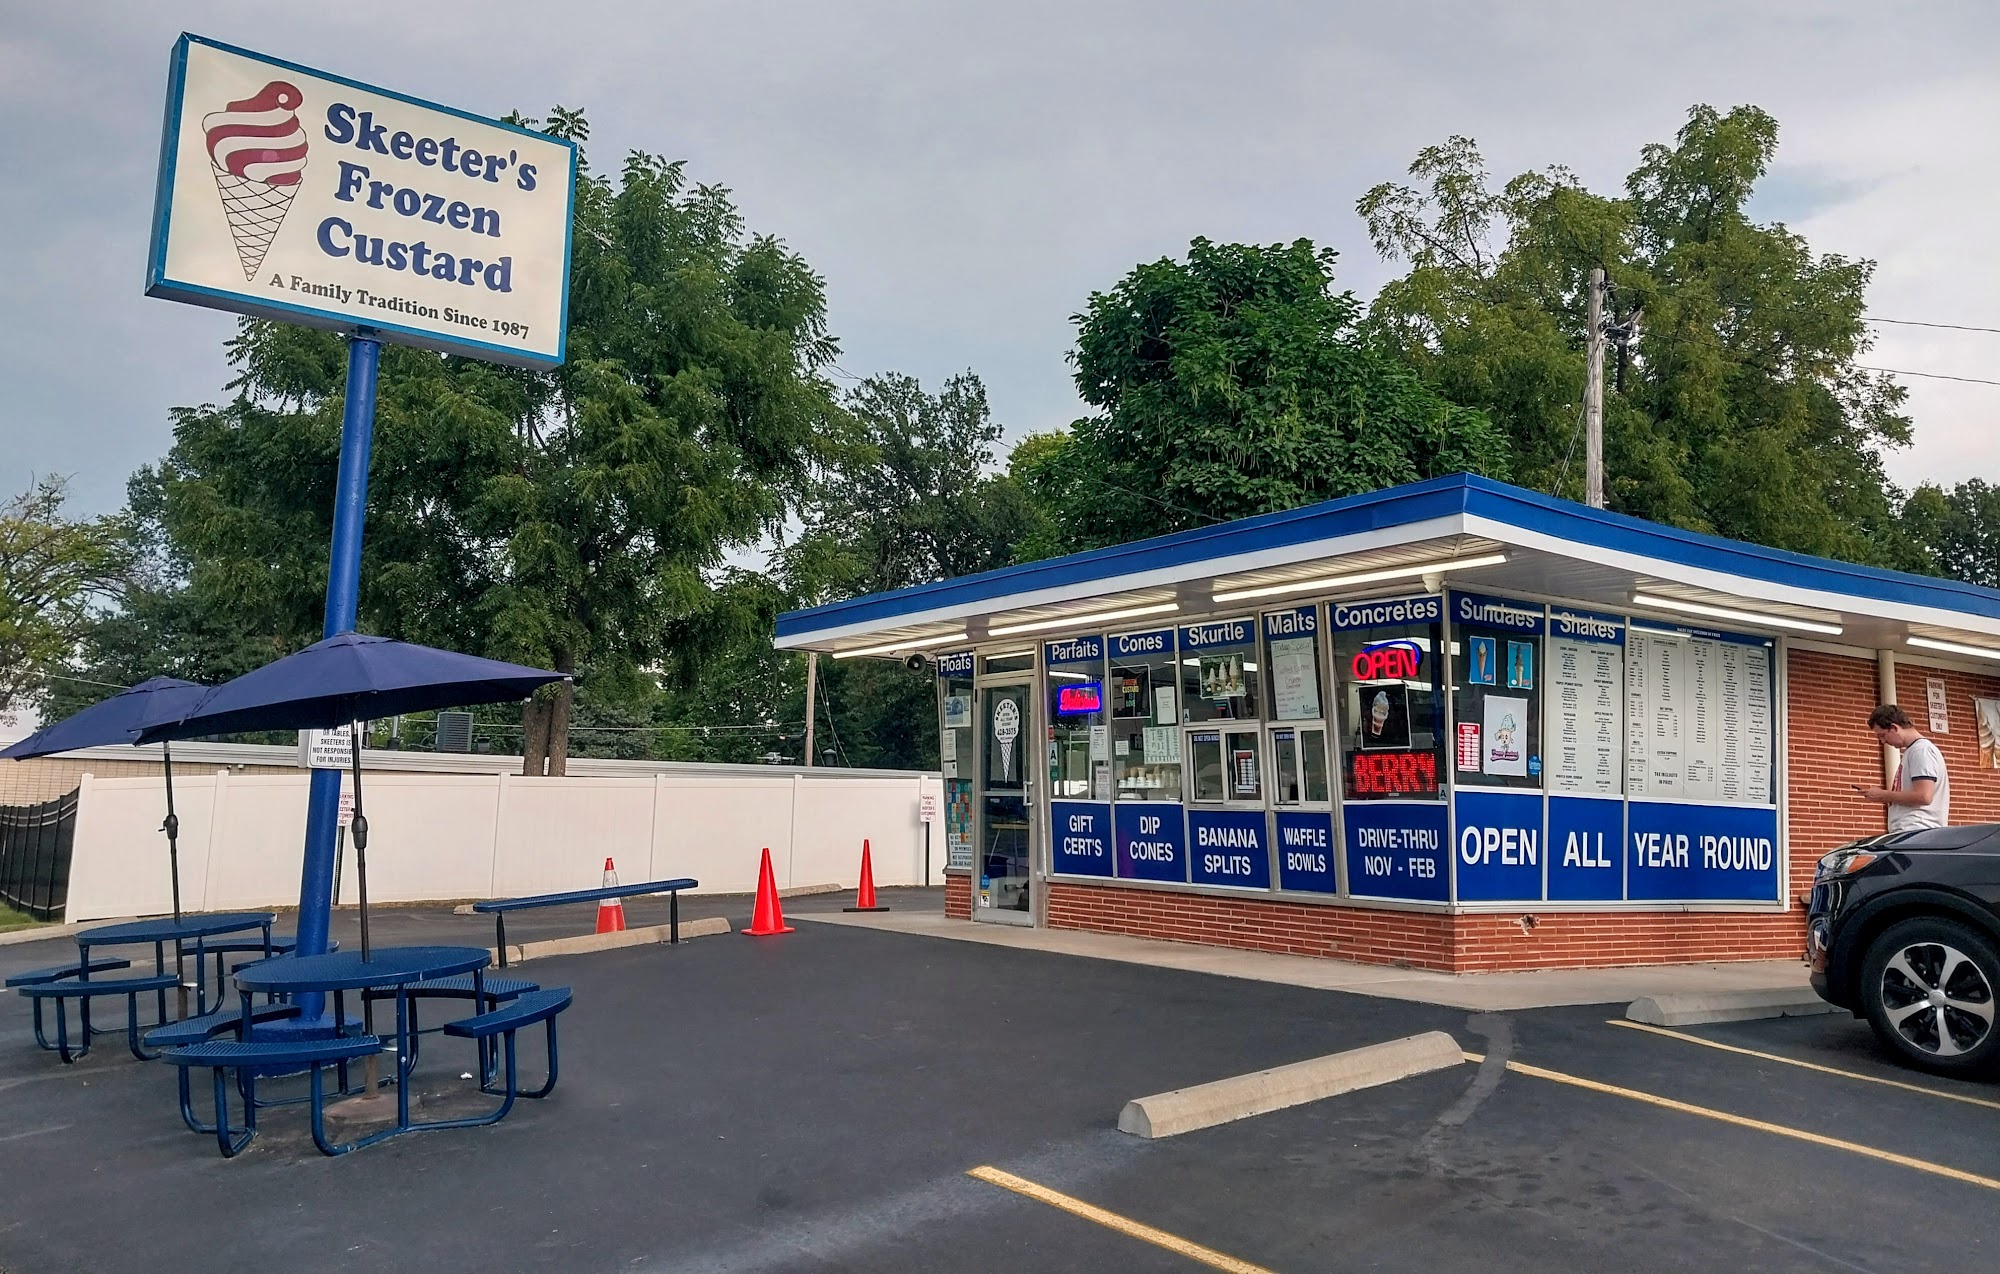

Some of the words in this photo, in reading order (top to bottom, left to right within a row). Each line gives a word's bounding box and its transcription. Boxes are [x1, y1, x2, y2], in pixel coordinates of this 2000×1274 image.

[324, 102, 538, 192] Skeeter's
[334, 159, 501, 238] Frozen
[316, 216, 513, 293] Custard
[269, 274, 284, 288] A
[290, 275, 352, 303] Family
[357, 289, 439, 319] Tradition
[442, 308, 488, 328] Since
[492, 320, 529, 339] 1987
[1334, 600, 1438, 627] Concretes
[1460, 598, 1535, 628] Sundaes
[1189, 624, 1244, 645] Skurtle
[1268, 613, 1315, 635] Malts
[1560, 612, 1616, 639] Shakes
[1052, 642, 1098, 661] Parfaits
[1119, 635, 1163, 653] Cones
[940, 657, 972, 672] Floats
[1352, 648, 1417, 680] OPEN
[1051, 750, 1056, 760] A
[1354, 753, 1437, 792] BERRY
[1440, 789, 1447, 799] A
[1069, 815, 1094, 832] GIFT
[1139, 816, 1160, 835] DIP
[1064, 837, 1102, 857] CERT'S
[1198, 827, 1258, 848] BANANA
[1284, 828, 1326, 847] WAFFLE
[1358, 828, 1438, 850] DRIVE-THRU
[1461, 826, 1537, 865] OPEN
[1563, 831, 1611, 868] ALL
[1634, 832, 1689, 868] YEAR
[1700, 836, 1772, 870] 'ROUND
[1130, 841, 1174, 862] CONES
[1204, 854, 1251, 875] SPLITS
[1288, 852, 1326, 873] BOWLS
[1365, 856, 1392, 876] NOV
[1408, 857, 1436, 878] FEB
